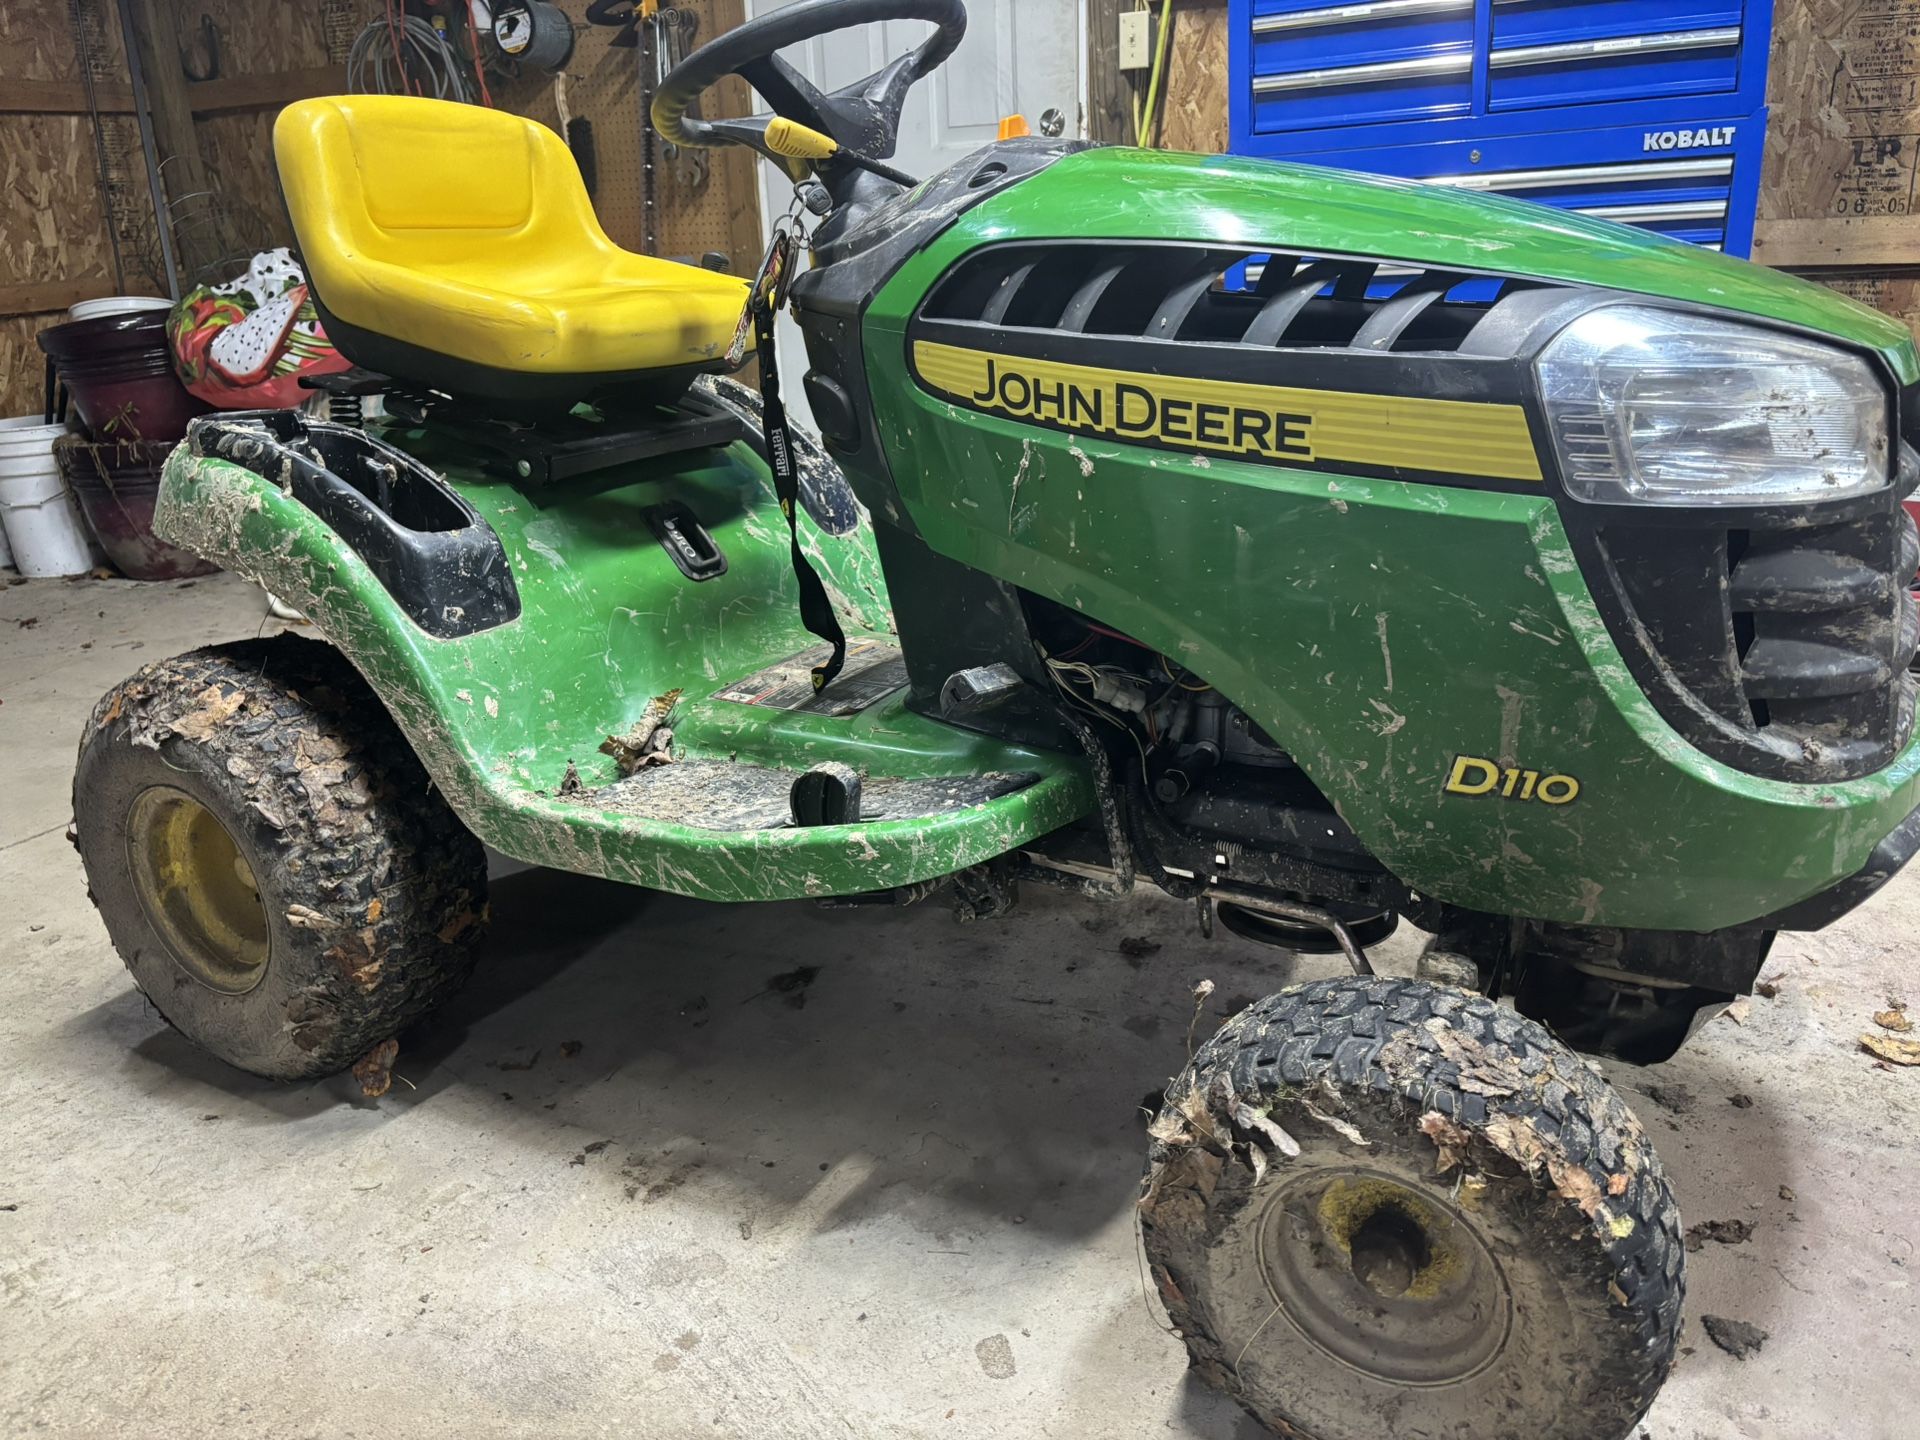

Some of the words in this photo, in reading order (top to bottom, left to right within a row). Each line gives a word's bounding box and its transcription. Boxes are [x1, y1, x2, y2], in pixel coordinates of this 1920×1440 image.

[1643, 127, 1736, 151] KOBALT
[973, 359, 1102, 425] JOHN
[1115, 383, 1312, 455] DEERE
[771, 427, 789, 476] Ferrari
[1446, 756, 1579, 804] D110
